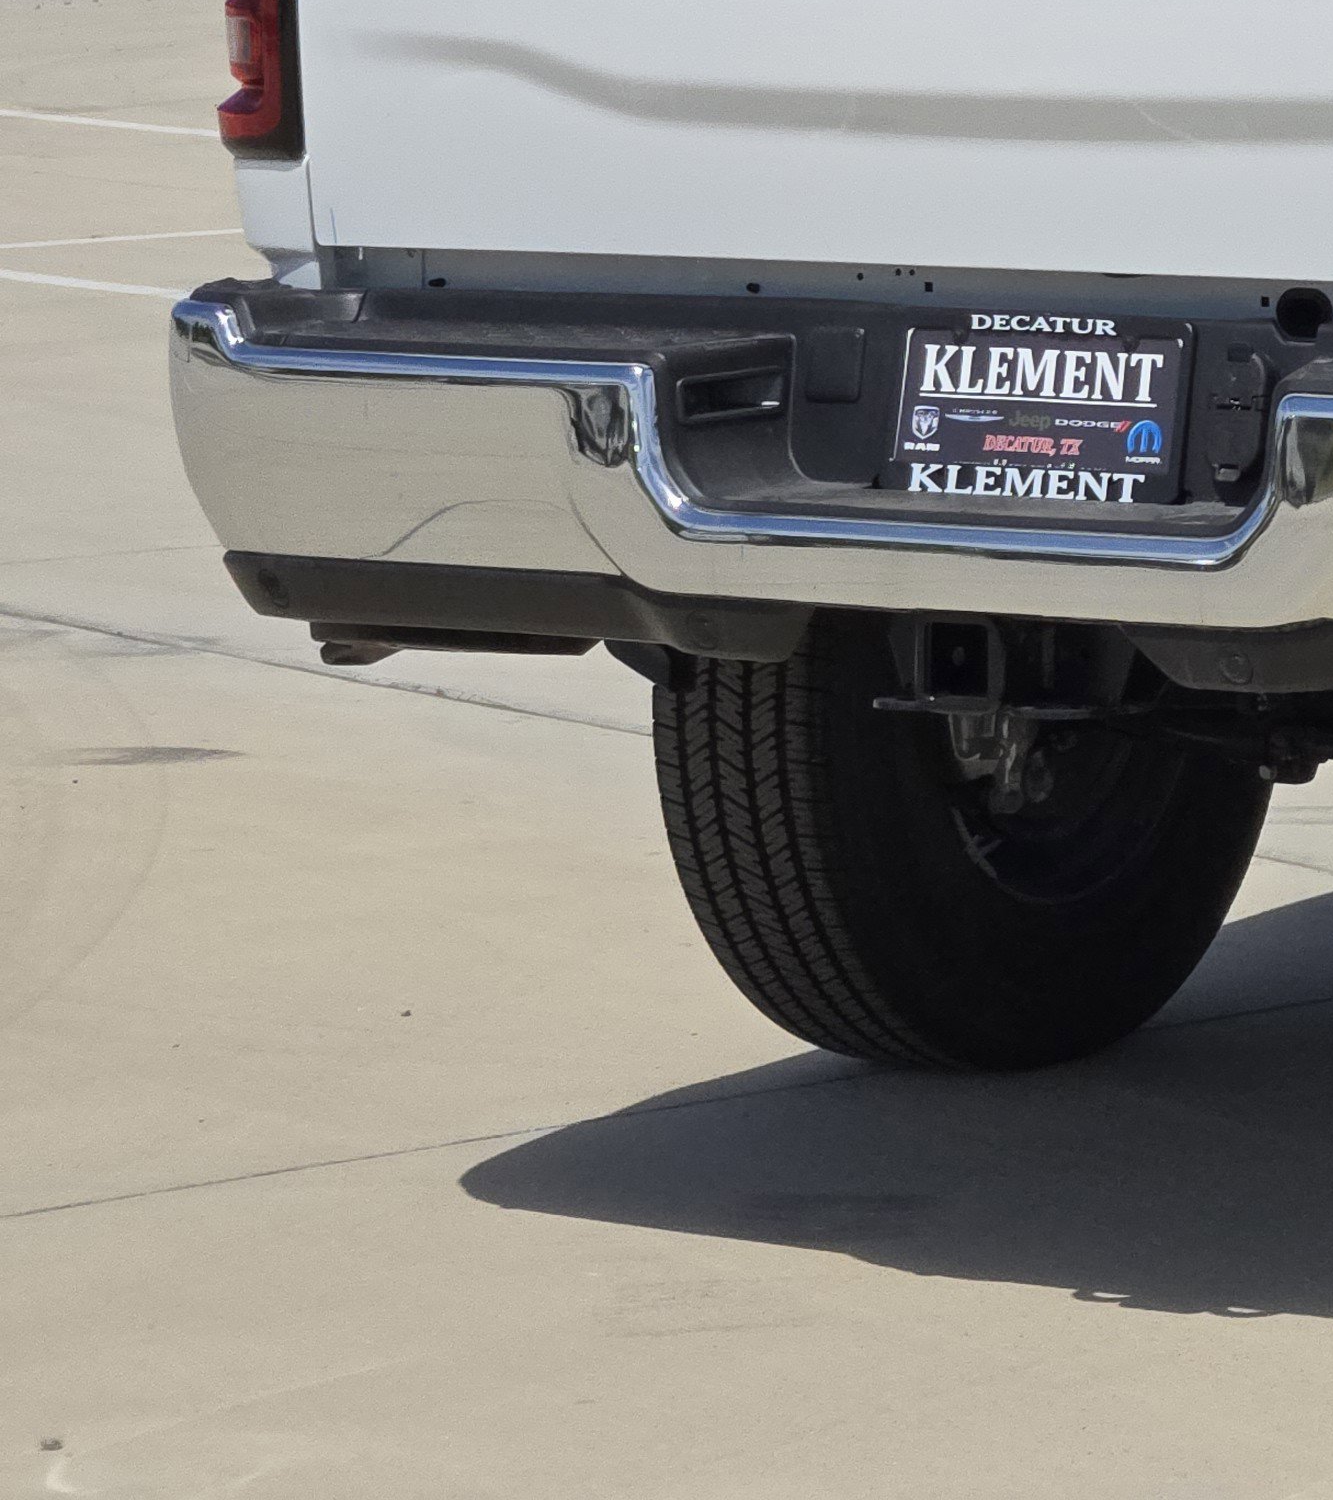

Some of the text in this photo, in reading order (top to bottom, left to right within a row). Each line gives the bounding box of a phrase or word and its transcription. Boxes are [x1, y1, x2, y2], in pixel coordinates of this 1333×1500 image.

[971, 313, 1118, 337] DECATUR
[919, 343, 1165, 402] KLEMENT
[1009, 410, 1051, 431] Jeep
[1054, 419, 1121, 429] DODGE
[983, 434, 1083, 457] DECATUR, TX
[908, 462, 1146, 503] KLEMENT
